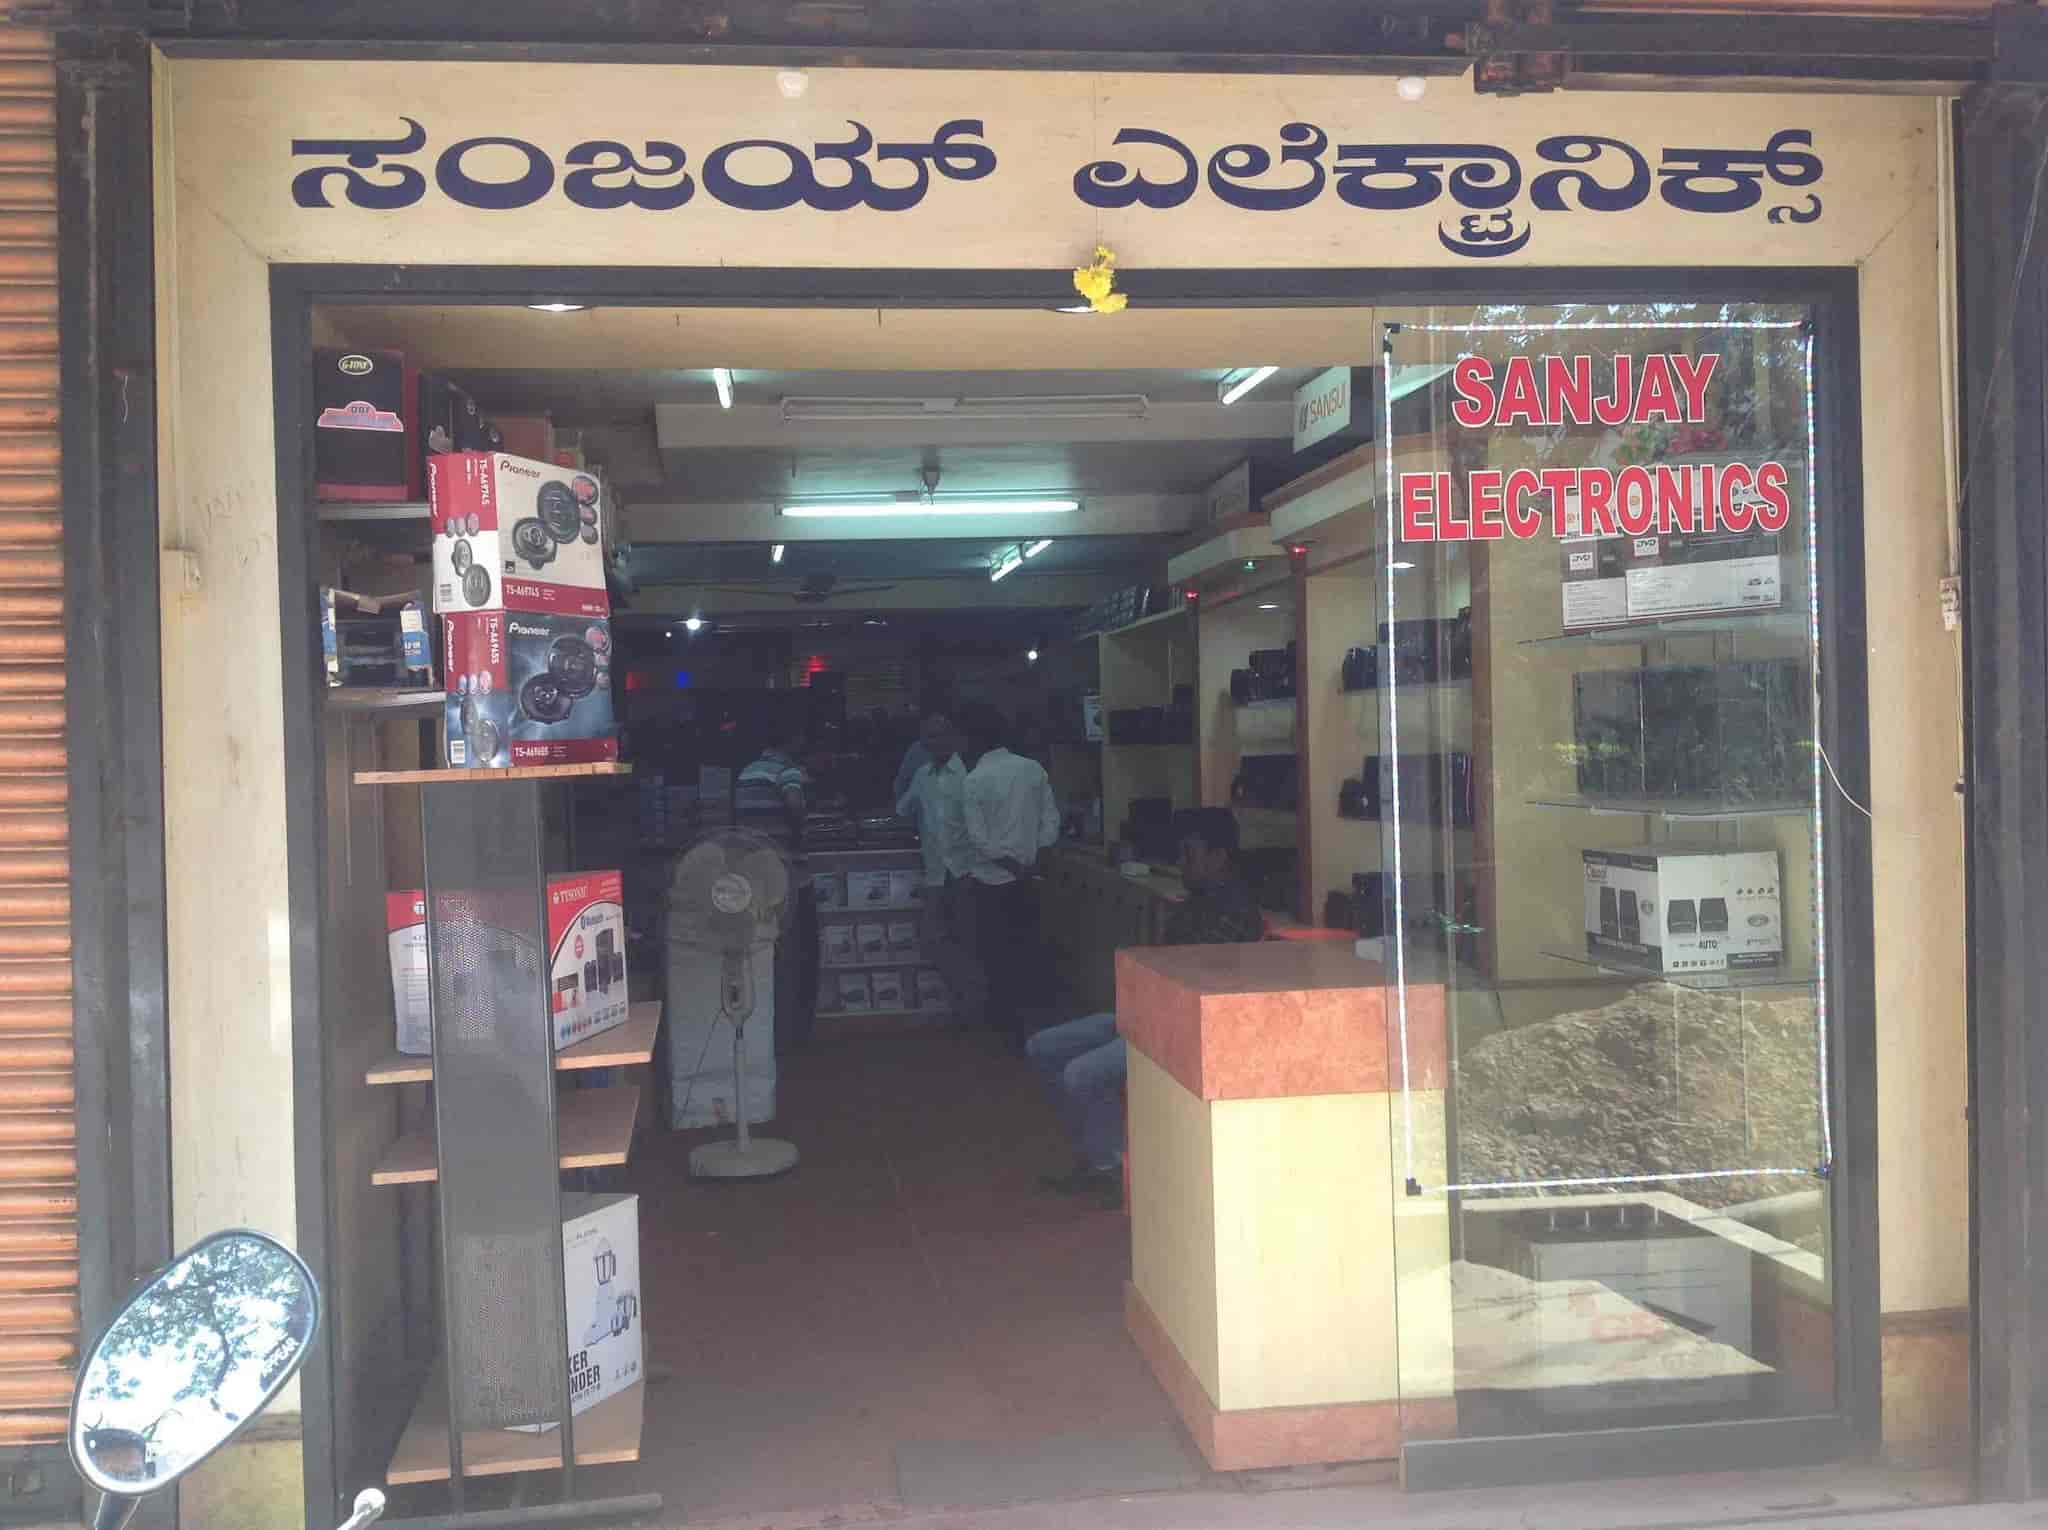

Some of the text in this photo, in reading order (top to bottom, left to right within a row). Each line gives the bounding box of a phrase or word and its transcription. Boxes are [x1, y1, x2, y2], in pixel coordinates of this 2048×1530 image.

[291, 116, 997, 212] ಸಂಜಯ್
[1453, 353, 1720, 428] SANJAY
[500, 460, 541, 479] Pioneer
[1400, 461, 1790, 542] ELECTRONICS
[509, 622, 549, 636] Pioneer
